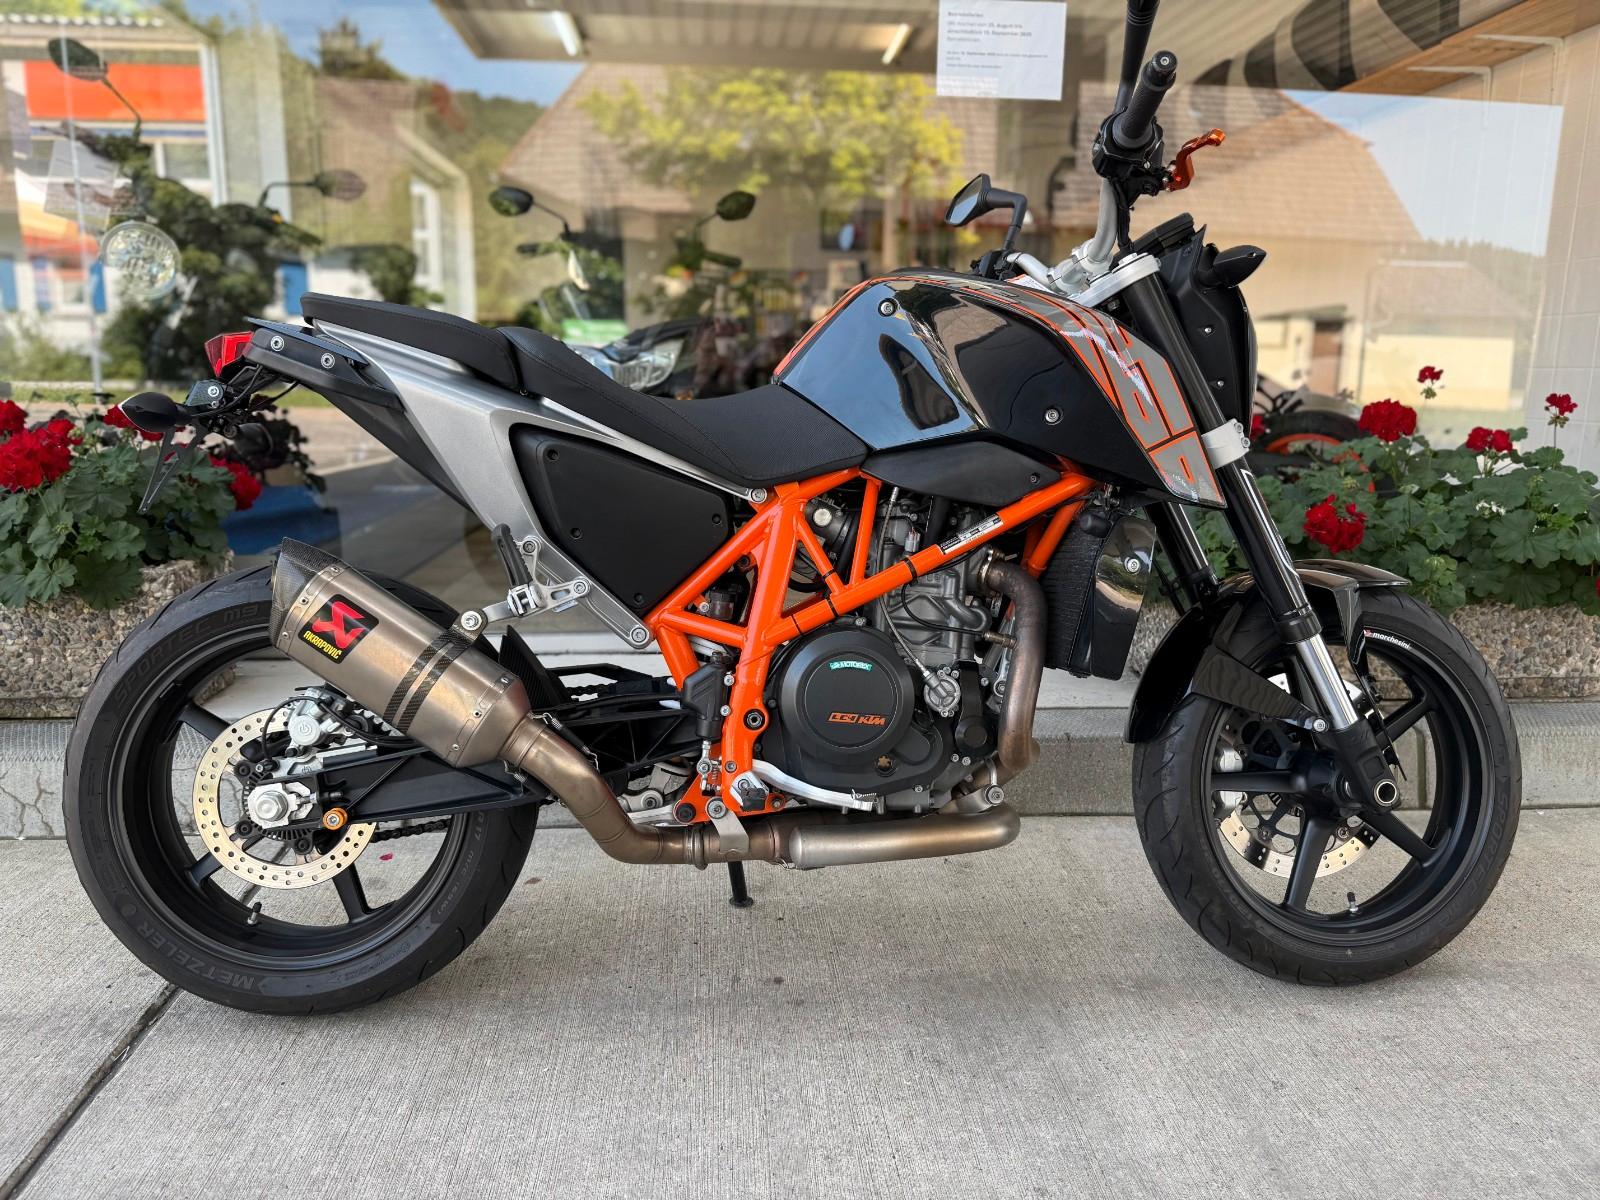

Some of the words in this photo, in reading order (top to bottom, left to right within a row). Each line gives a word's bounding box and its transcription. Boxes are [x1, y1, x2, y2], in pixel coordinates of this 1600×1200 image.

[1372, 632, 1411, 650] marchesini
[858, 714, 886, 725] KTM
[136, 921, 255, 990] METZELER
